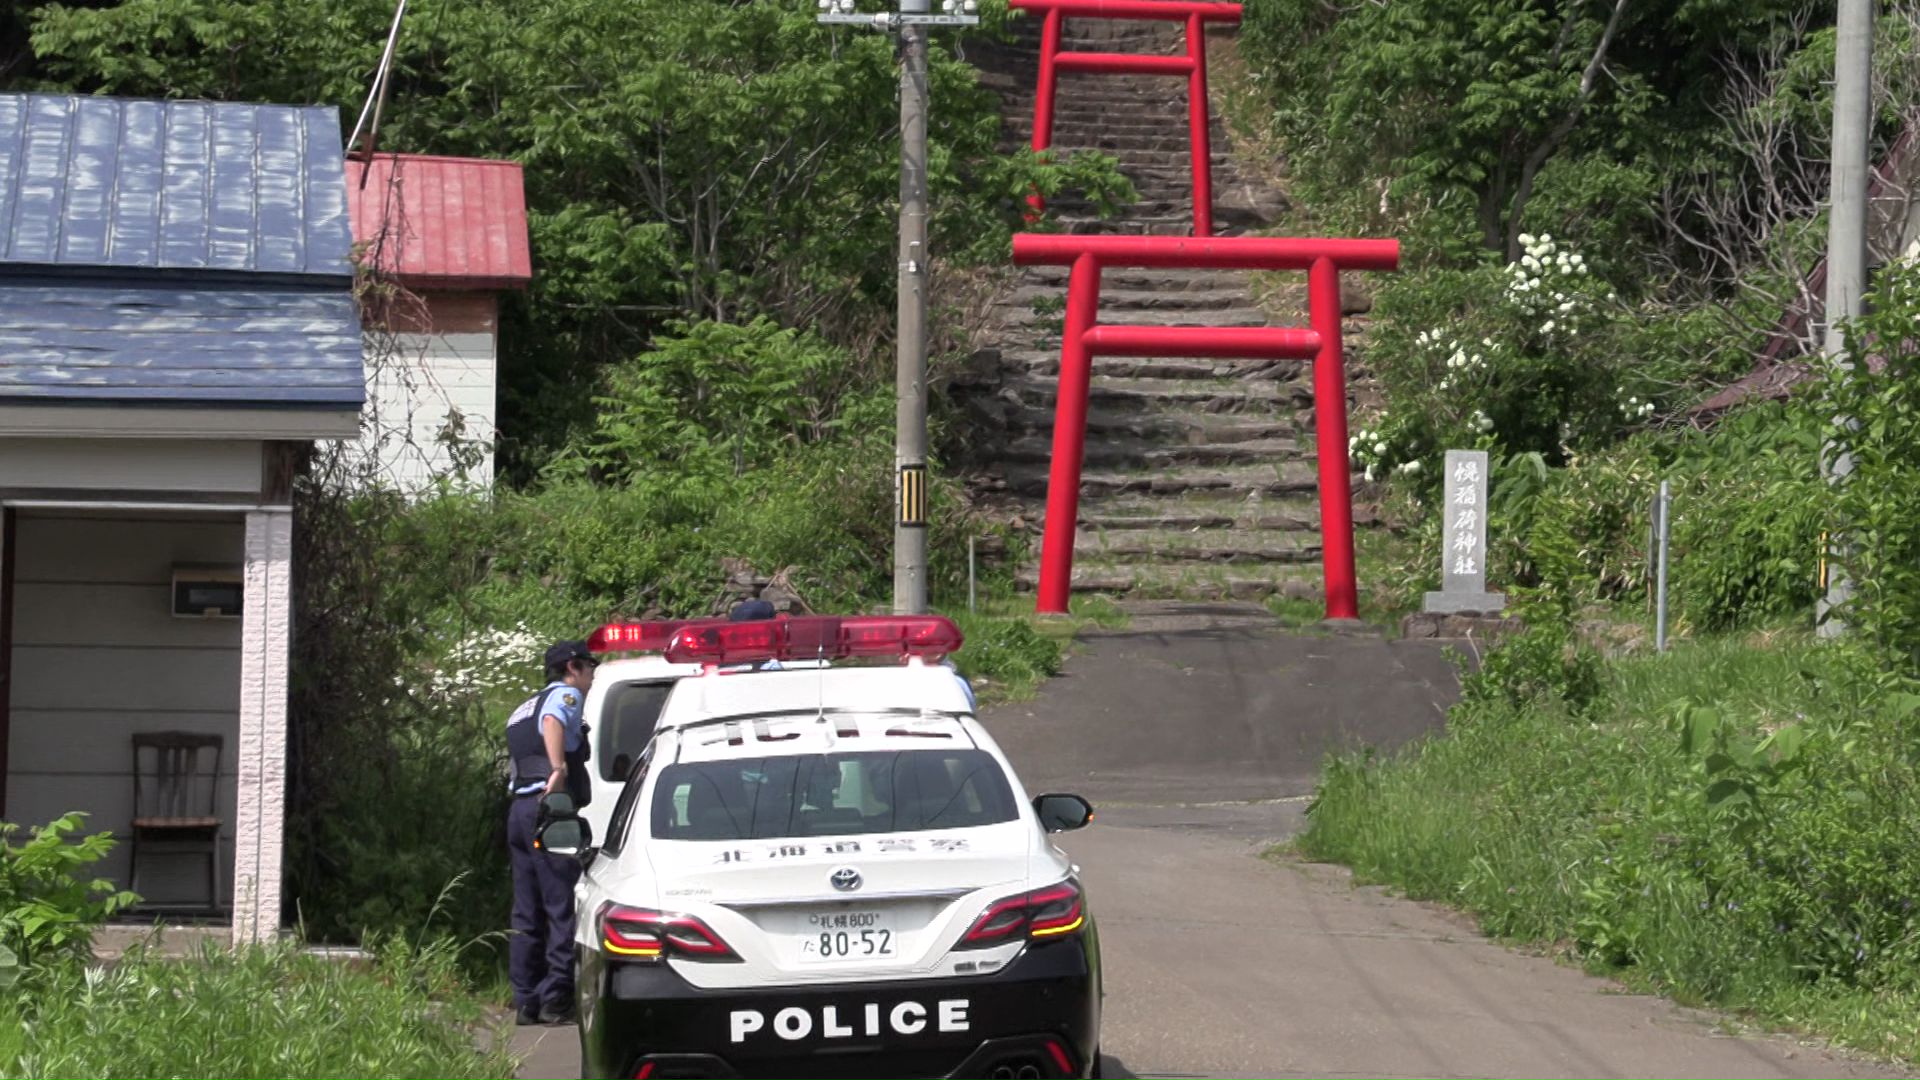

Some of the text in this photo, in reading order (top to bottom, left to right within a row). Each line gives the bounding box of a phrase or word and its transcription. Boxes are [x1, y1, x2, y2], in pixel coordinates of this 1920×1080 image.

[820, 912, 874, 928] 札幌 800
[803, 929, 892, 957] た 80-52
[730, 999, 970, 1043] POLICE
